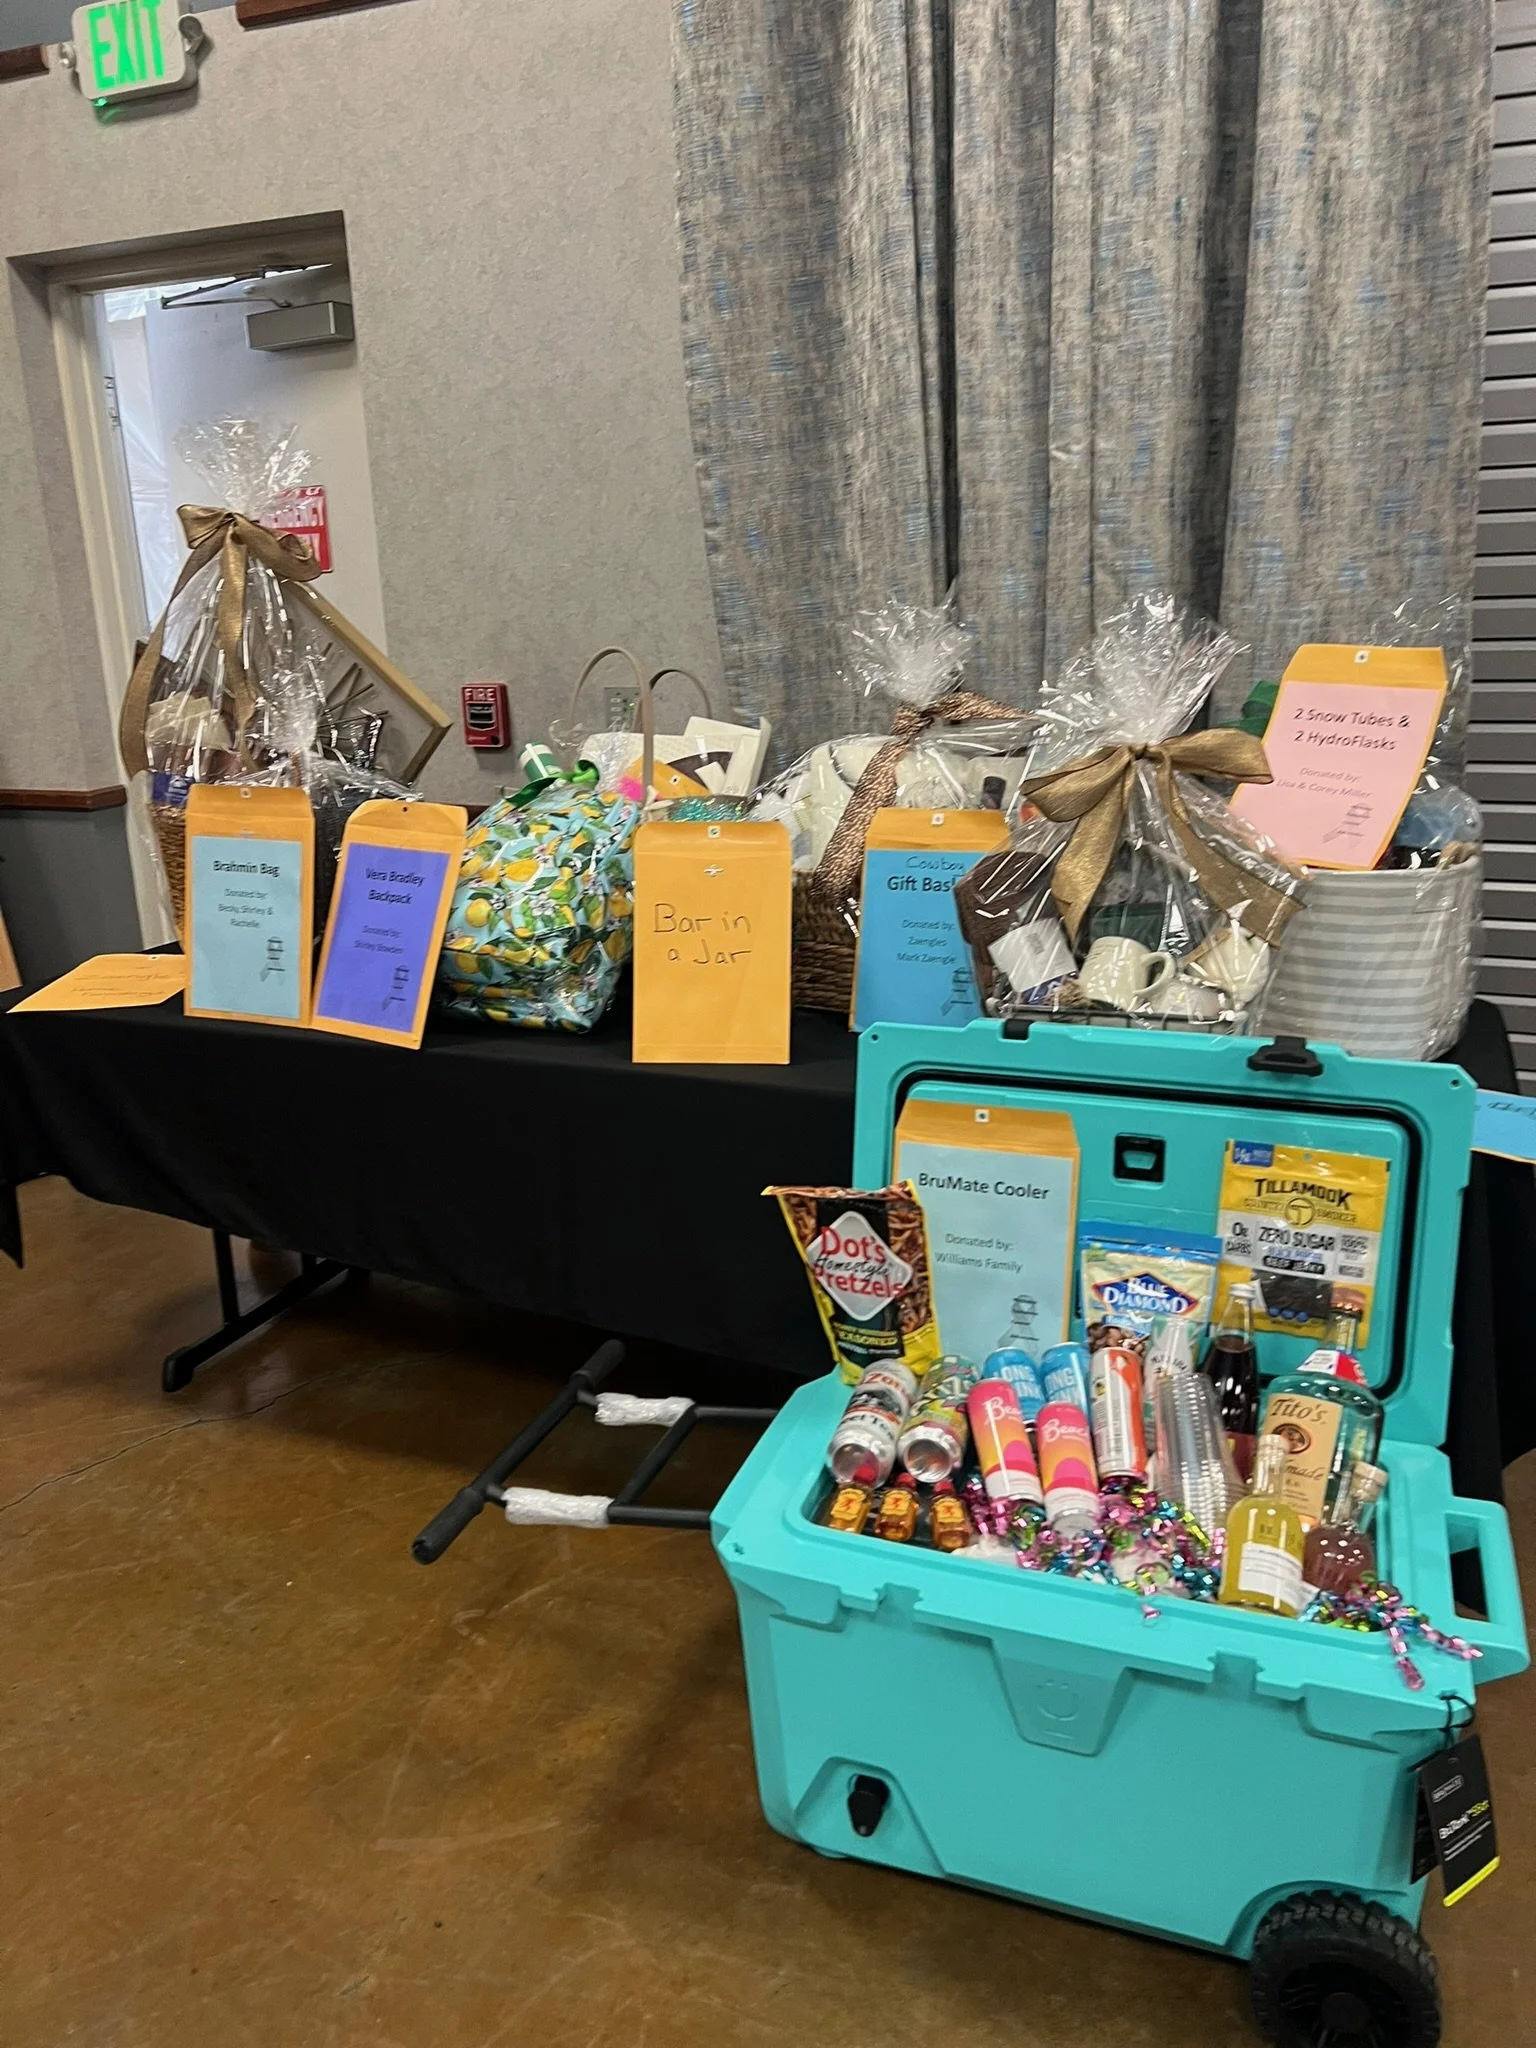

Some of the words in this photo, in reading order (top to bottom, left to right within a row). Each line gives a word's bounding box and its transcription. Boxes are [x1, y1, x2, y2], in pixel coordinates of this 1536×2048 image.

[87, 0, 165, 91] EXIT
[464, 687, 497, 702] FIRE
[1293, 707, 1305, 721] 2
[1306, 708, 1349, 725] Snow
[1350, 711, 1395, 728] Tubes
[1397, 714, 1411, 728] &
[1293, 730, 1305, 743] 2
[1307, 732, 1398, 751] HydroFlasks
[1338, 787, 1374, 799] Miller
[213, 860, 258, 874] Brahmin
[260, 863, 281, 879] Bag
[365, 868, 388, 882] Vera
[388, 871, 425, 887] Bradley
[368, 888, 412, 905] Backpack
[887, 876, 919, 892] Gift
[921, 877, 957, 893] Bas
[653, 902, 712, 933] Bar
[721, 910, 751, 934] in
[667, 948, 681, 961] a
[693, 938, 752, 965] Jar
[918, 1172, 989, 1194] BruMate
[993, 1181, 1051, 1200] Cooler
[1254, 1177, 1353, 1211] TILLAMOOK
[821, 1226, 886, 1264] Dot's
[944, 1232, 994, 1249] Donated
[1257, 1225, 1291, 1246] ZERO
[1292, 1230, 1336, 1251] SUGAR
[934, 1251, 983, 1268] Williams
[984, 1257, 1024, 1275] Family
[1102, 1285, 1190, 1315] DIAMOND
[1269, 1399, 1329, 1423] Tito's
